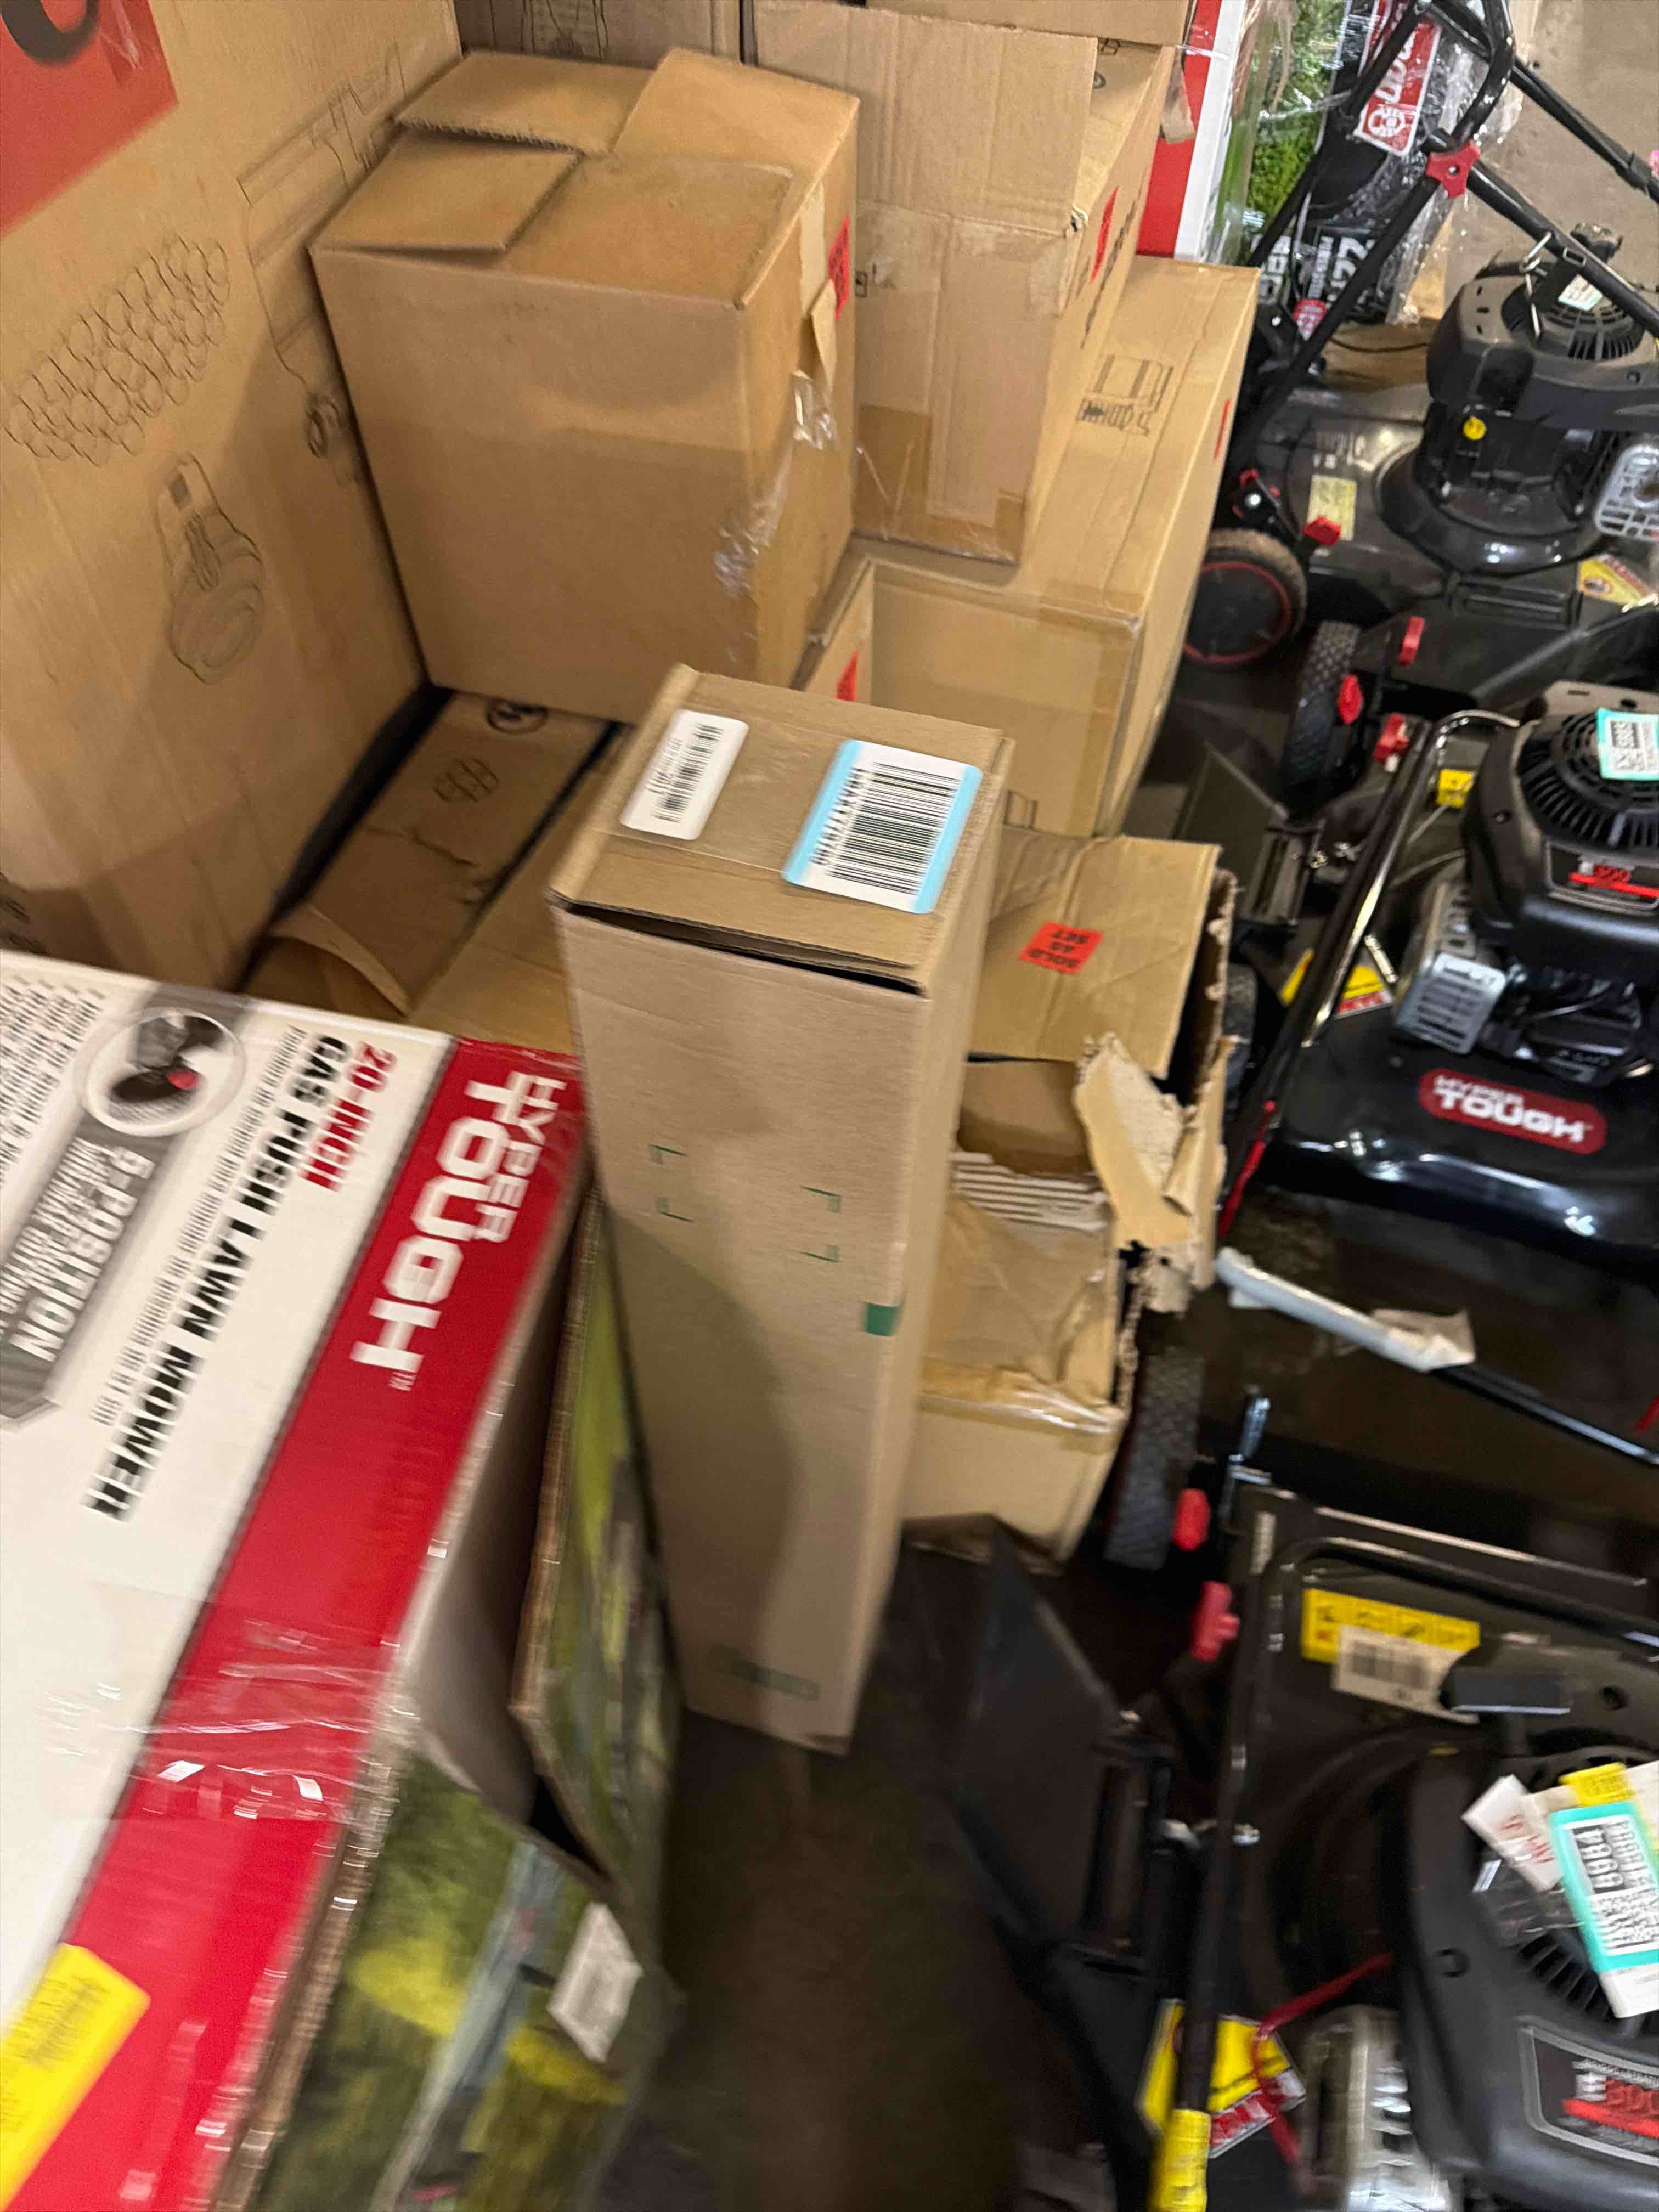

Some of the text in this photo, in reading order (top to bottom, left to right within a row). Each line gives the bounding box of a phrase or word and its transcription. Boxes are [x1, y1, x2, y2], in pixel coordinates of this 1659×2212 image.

[289, 1032, 352, 1108] GAS
[299, 1041, 397, 1193] 20-INCH
[1433, 1087, 1584, 1143] TOUGH
[229, 1105, 321, 1216] PUSH
[349, 1071, 531, 1372] TOUGH
[475, 1071, 567, 1243] HYPER
[167, 1214, 267, 1342] LAWN
[81, 1339, 206, 1522] MOWER
